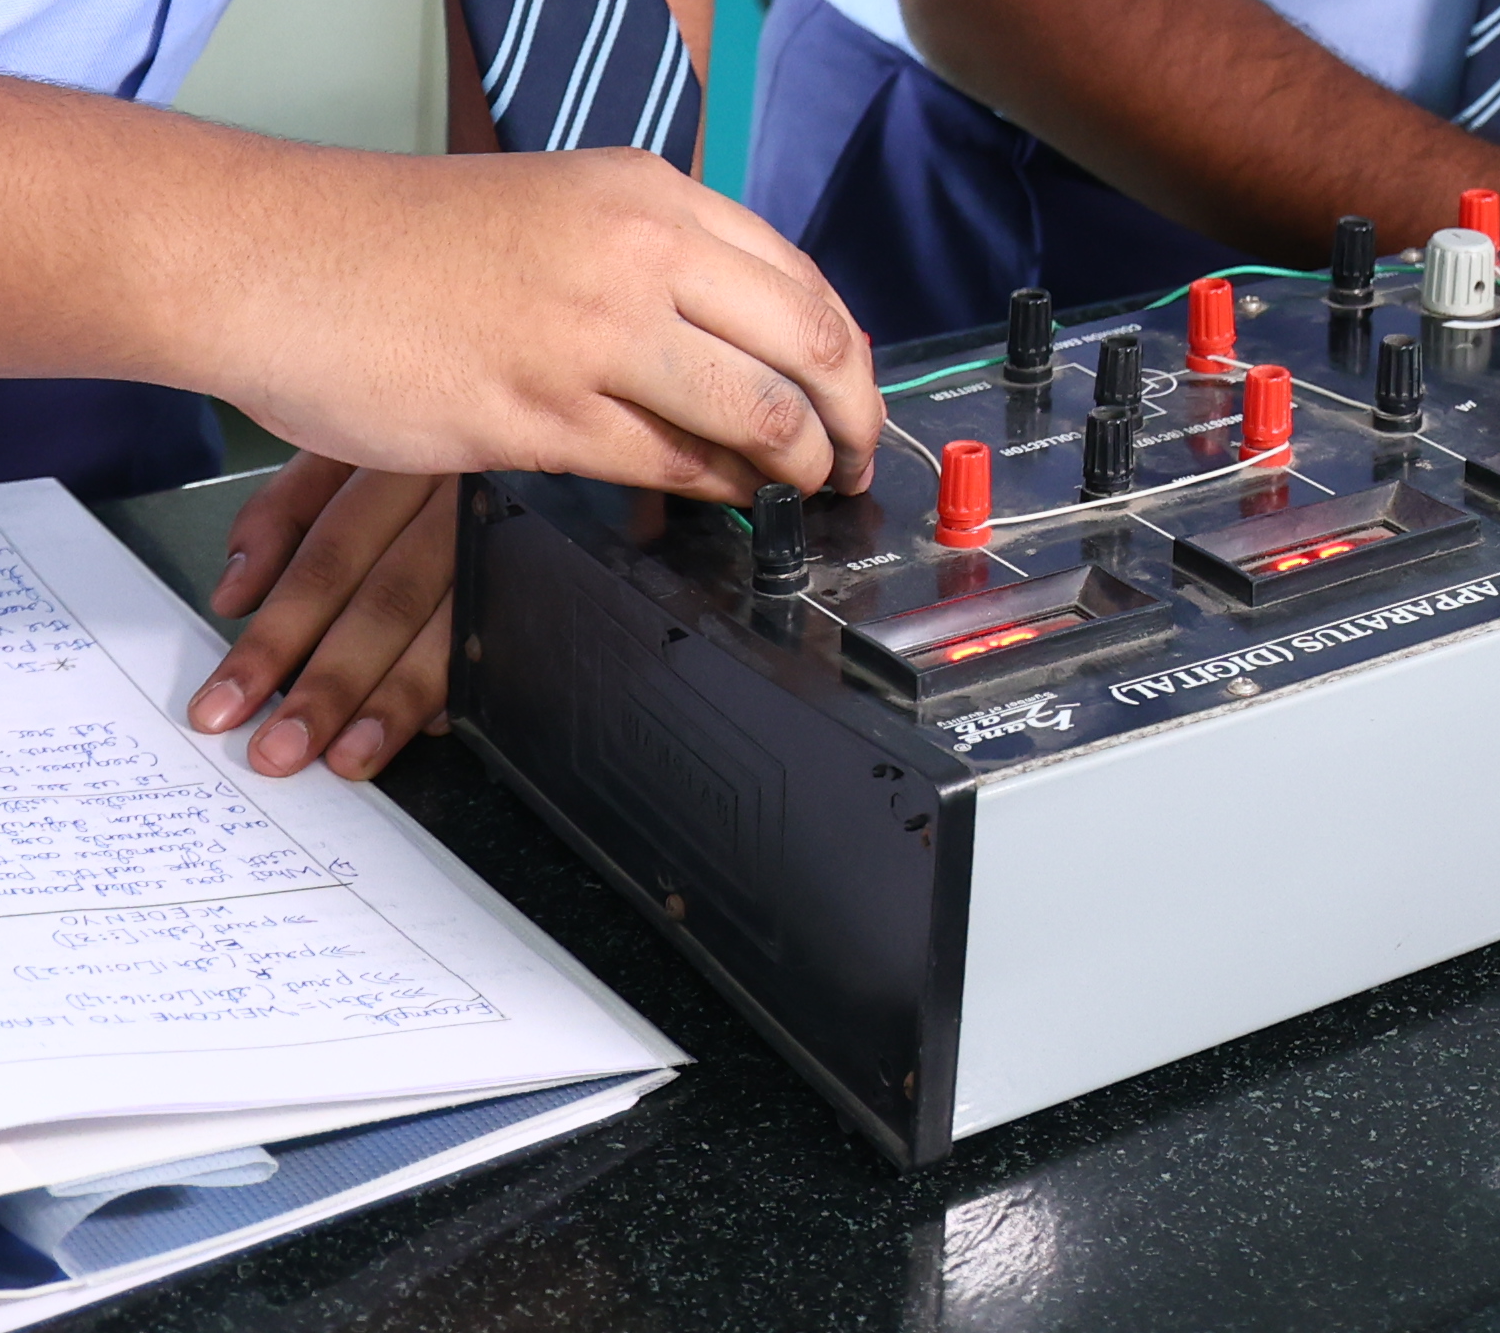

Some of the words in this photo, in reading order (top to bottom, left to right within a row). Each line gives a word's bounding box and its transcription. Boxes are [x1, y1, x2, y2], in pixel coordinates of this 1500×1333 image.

[999, 431, 1083, 457] COLLECTOR
[846, 551, 901, 571] VOLTS
[1291, 580, 1500, 654] APPARATUS
[23, 619, 70, 633] the
[43, 638, 96, 651] the
[1110, 644, 1294, 706] (DIGITAL)
[222, 805, 246, 816] a
[106, 807, 208, 831] function
[216, 821, 269, 835] and
[10, 836, 54, 847] are
[16, 851, 61, 861] are
[163, 853, 222, 874] type
[236, 848, 297, 866] with
[98, 865, 145, 876] and
[248, 865, 322, 881] What
[180, 873, 234, 886] are
[93, 879, 164, 897] called
[89, 1013, 135, 1025] TO
